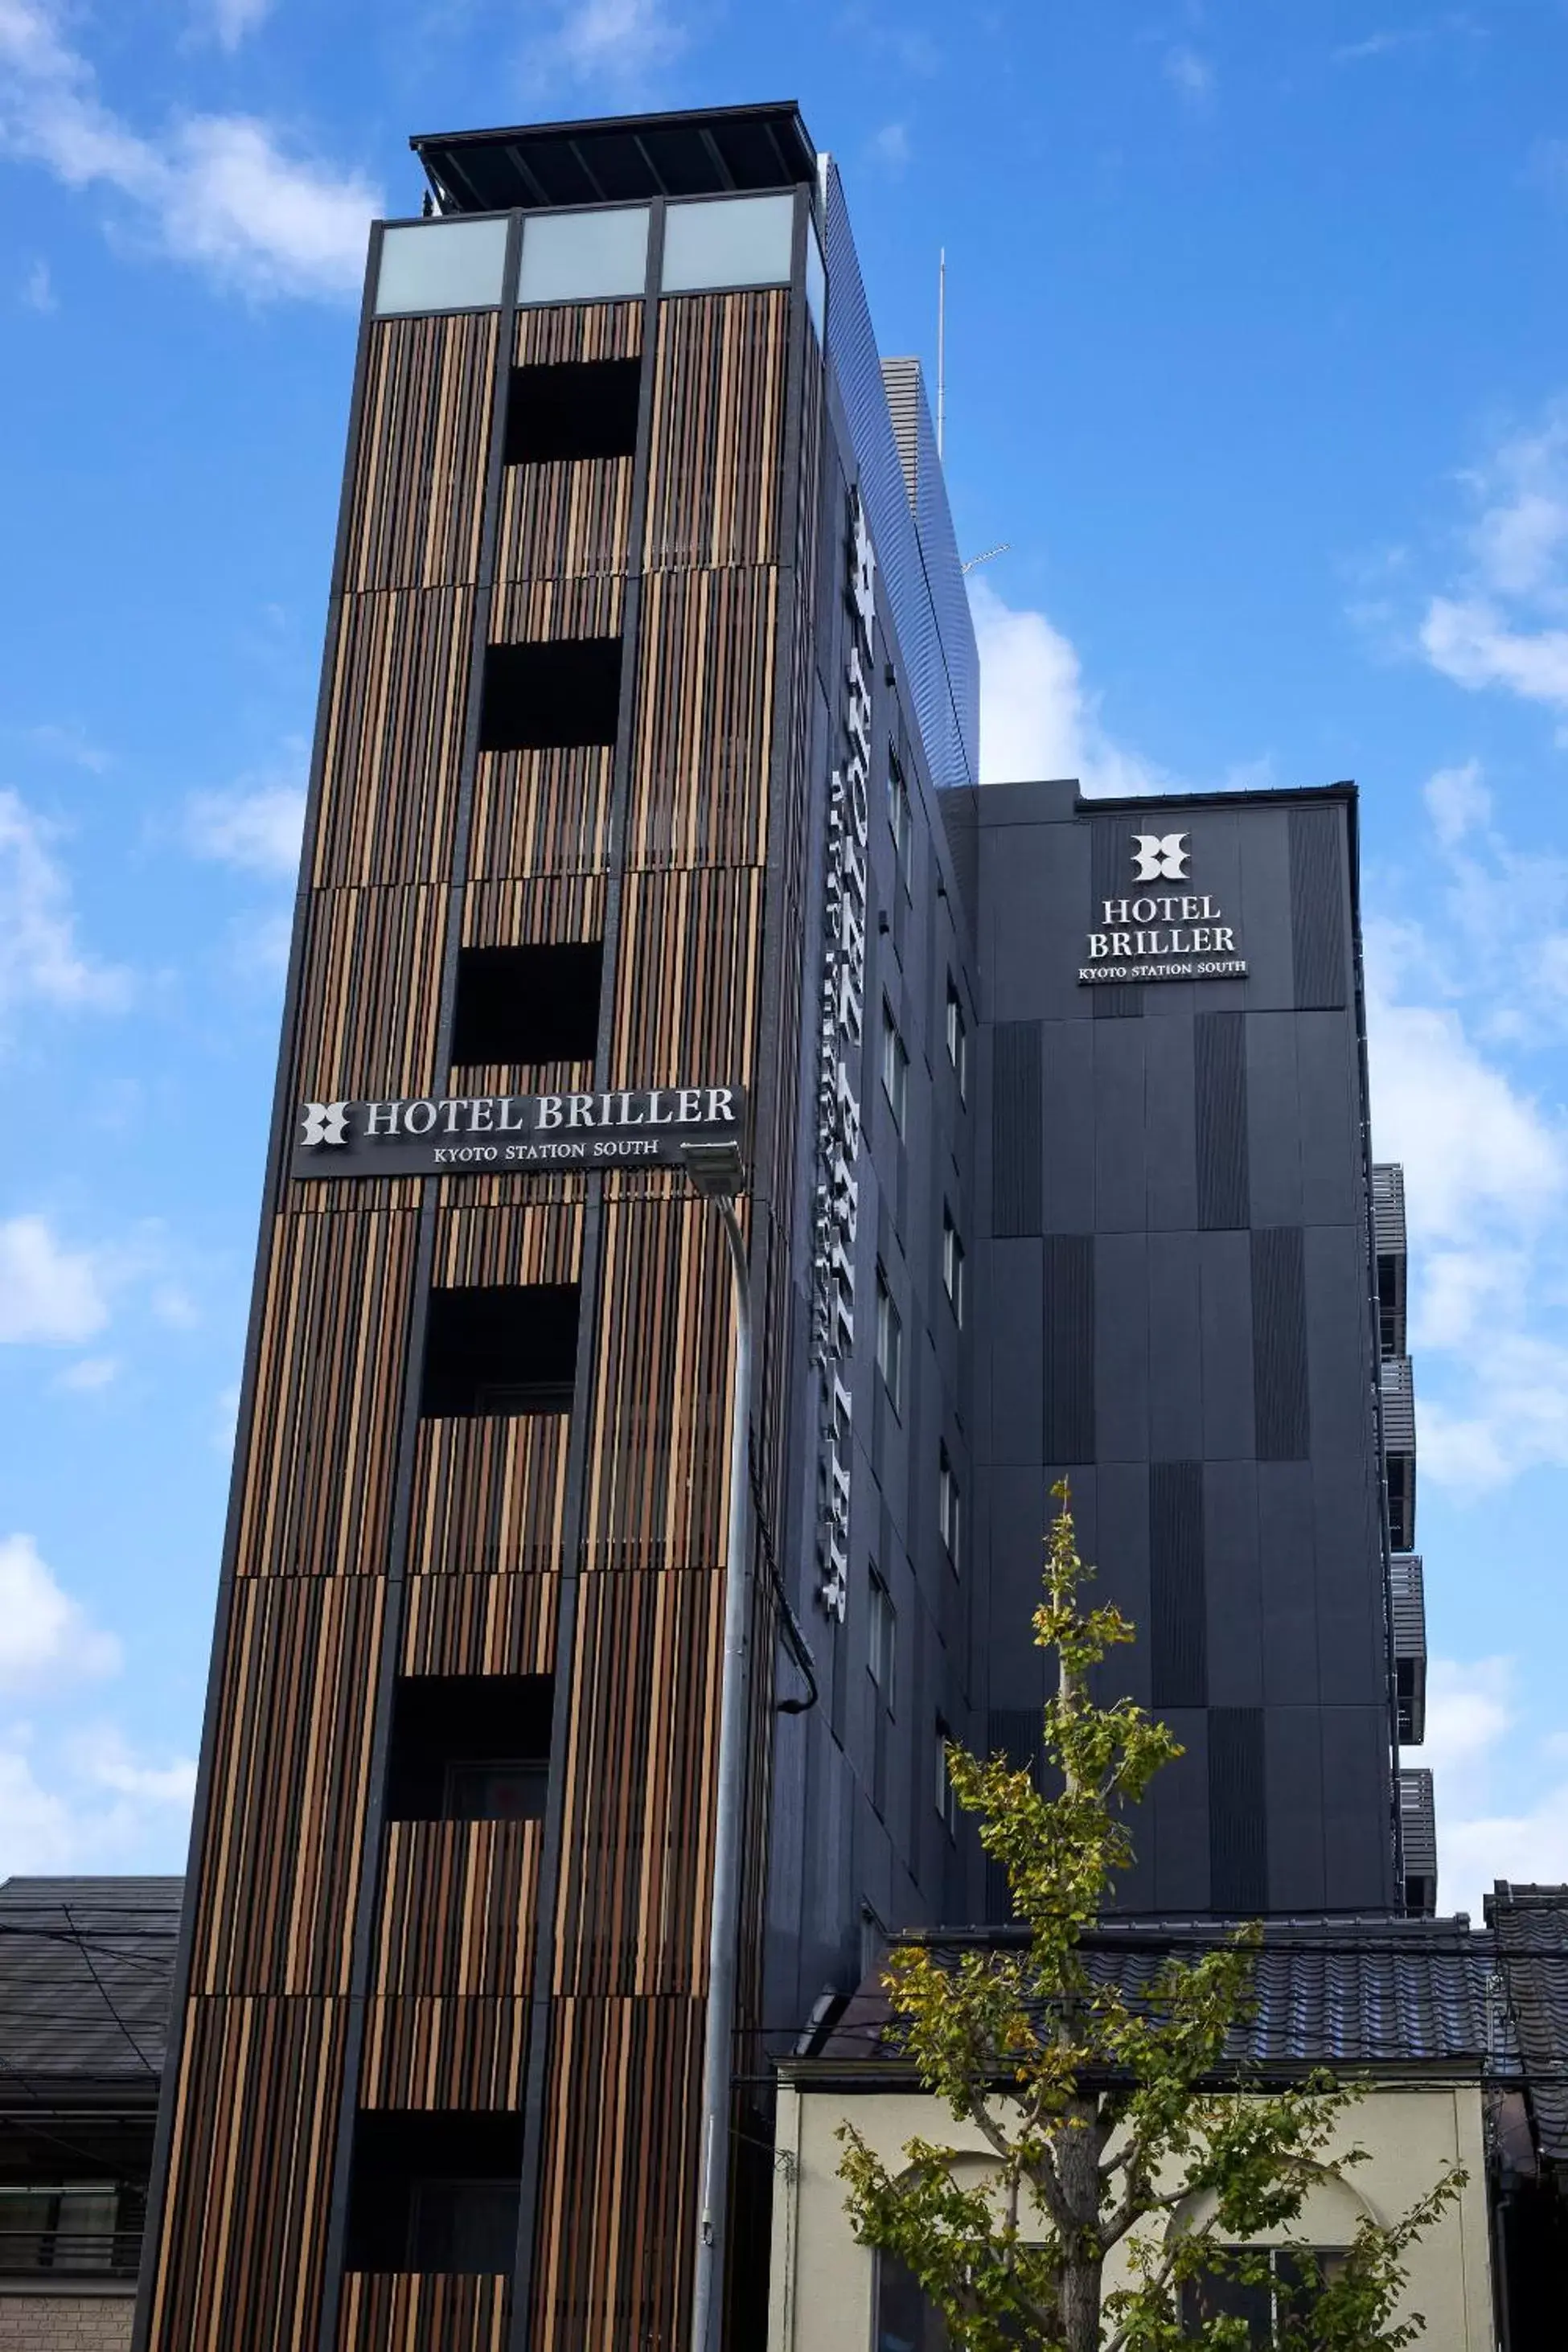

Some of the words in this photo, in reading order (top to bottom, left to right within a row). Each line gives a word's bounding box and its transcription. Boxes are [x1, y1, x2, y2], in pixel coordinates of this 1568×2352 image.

[1102, 895, 1221, 924] HOTEL
[1086, 927, 1235, 958] BRILLER
[1078, 967, 1127, 979] KYOTO
[1131, 963, 1192, 977] STATION
[1197, 961, 1246, 973] SOUTH
[363, 1098, 523, 1135] HOTEL
[535, 1088, 736, 1131] BRILLER
[434, 1147, 498, 1163] KYOTO
[506, 1143, 585, 1160] STATION
[593, 1139, 659, 1157] SOUTH
